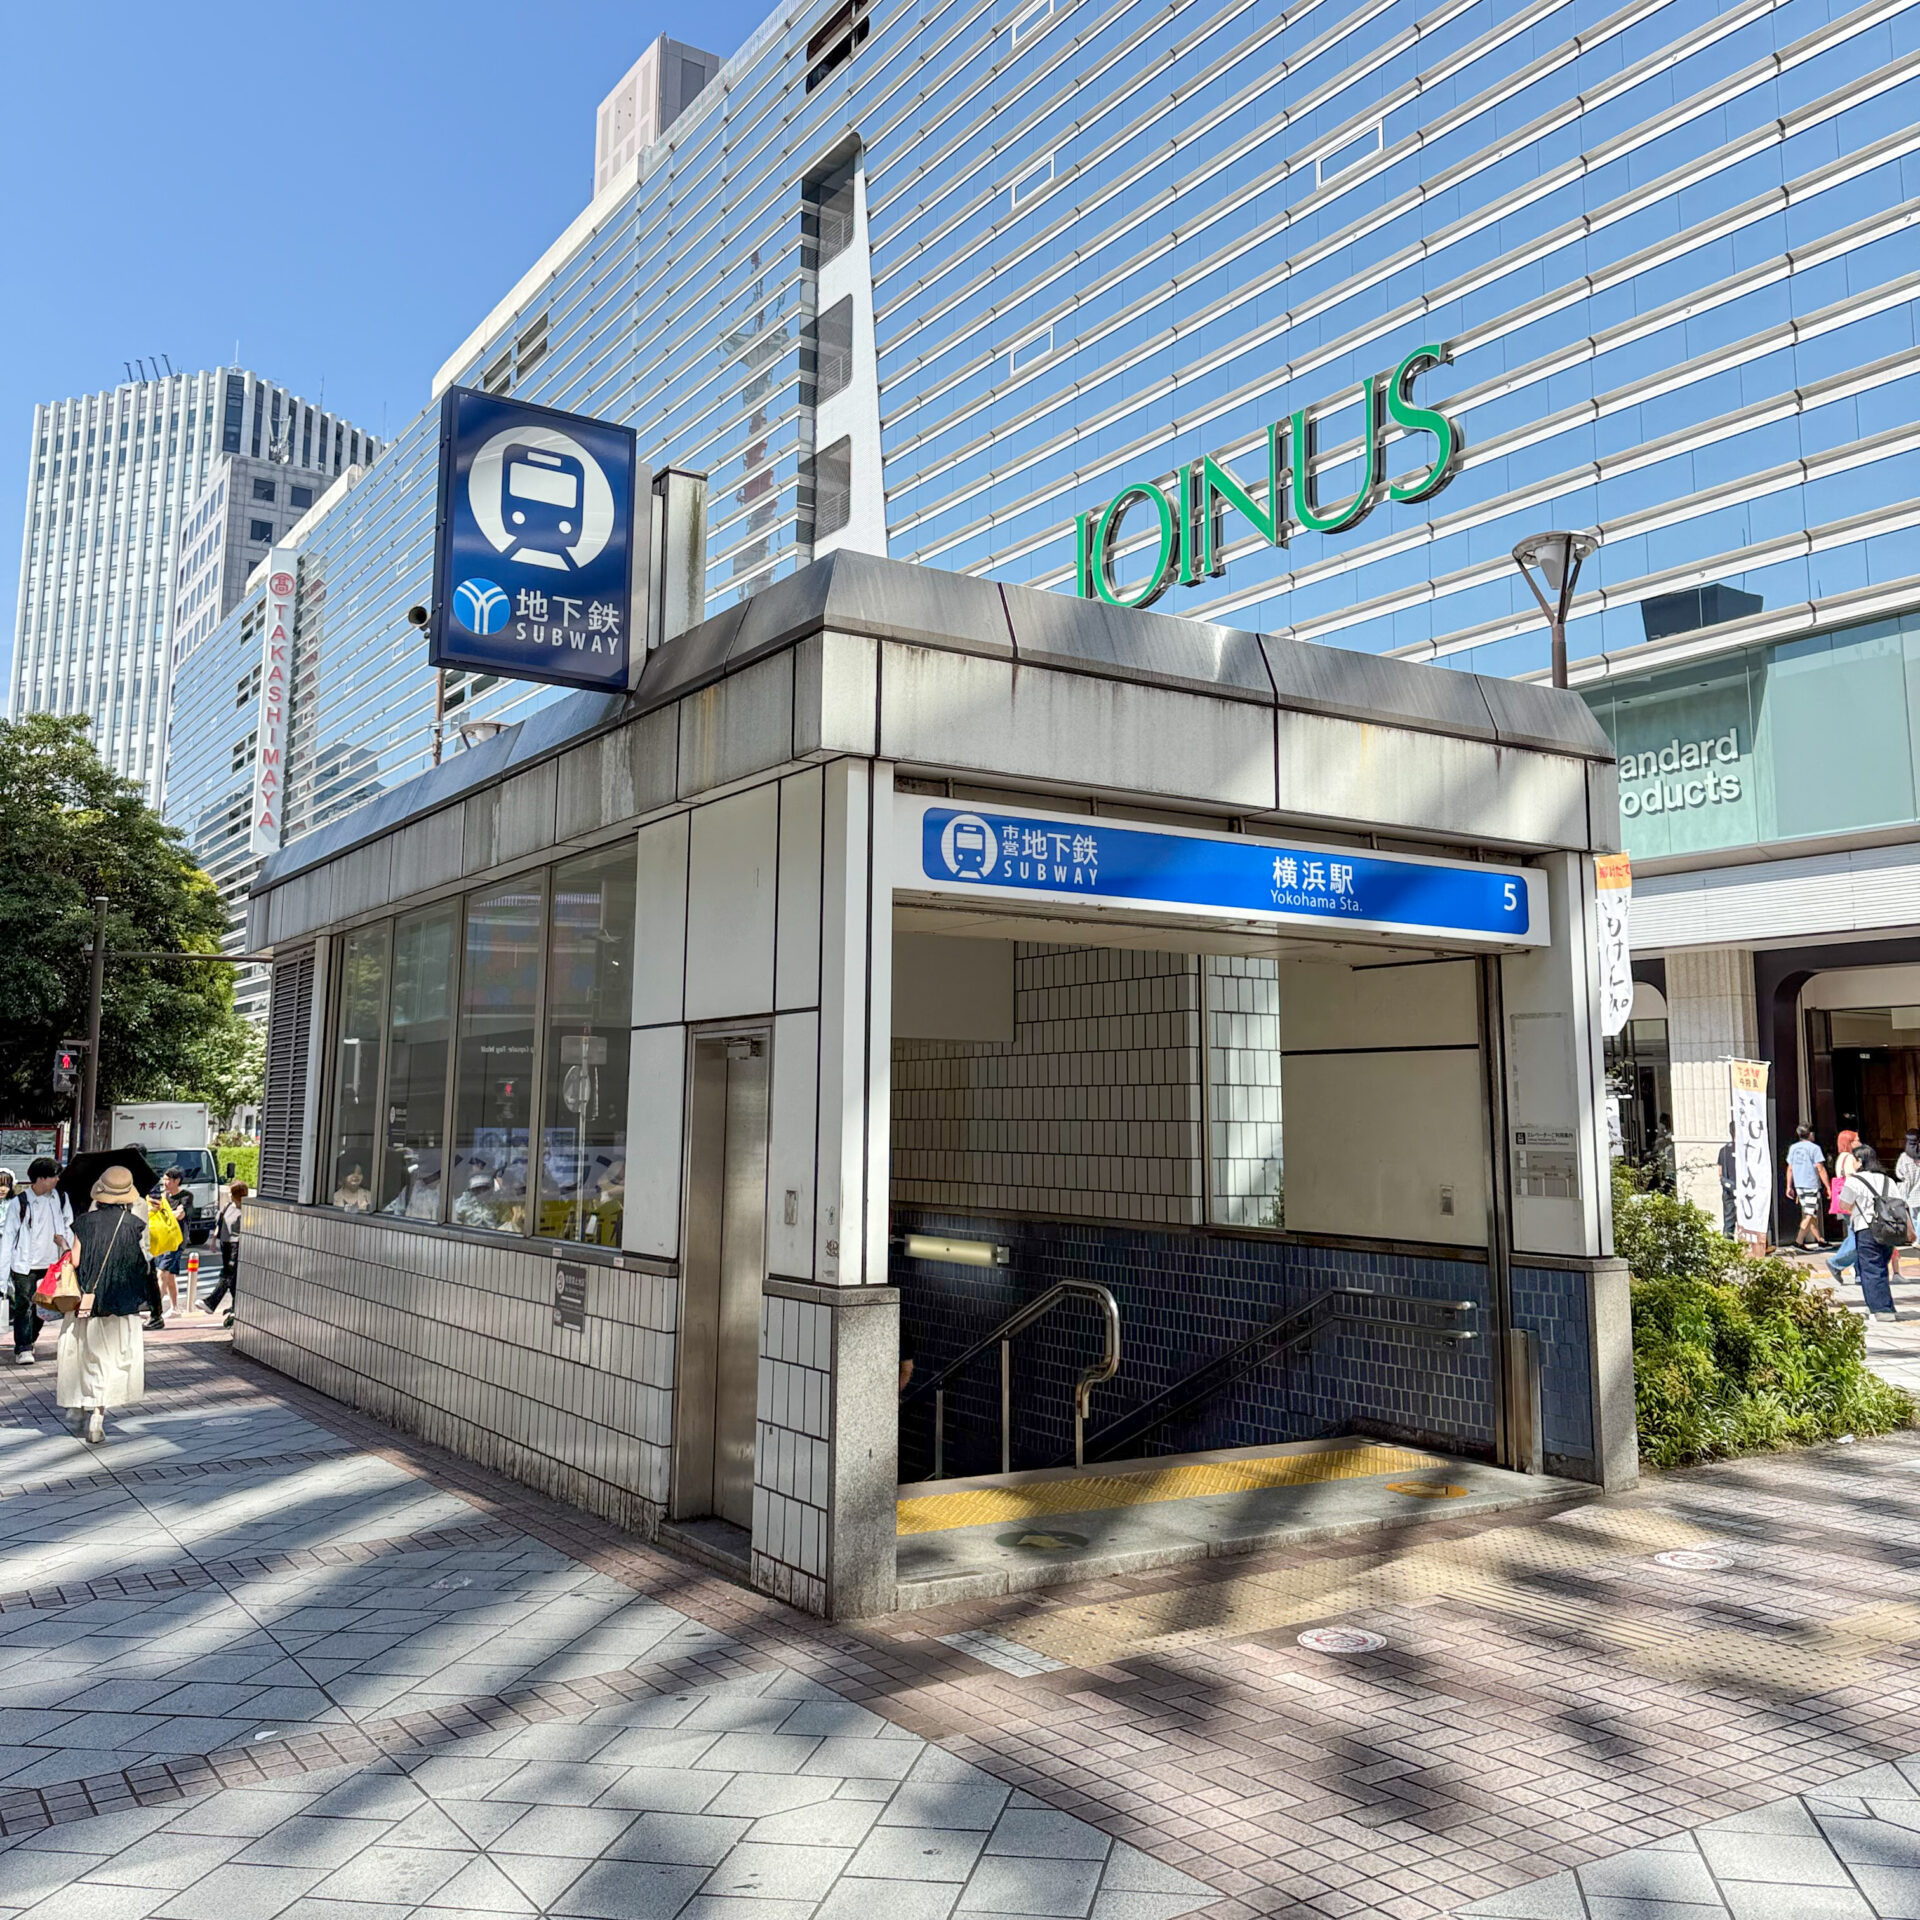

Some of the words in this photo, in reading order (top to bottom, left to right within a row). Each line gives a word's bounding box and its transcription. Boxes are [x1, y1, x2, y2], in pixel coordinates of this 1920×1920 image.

[516, 588, 620, 635] 地下鉄
[516, 622, 618, 656] SUBWAY
[259, 604, 285, 827] TAKASHIMAYA
[1619, 728, 1740, 781] andard
[1619, 770, 1741, 817] oducts
[1003, 860, 1098, 886] SUBWAY
[1272, 856, 1354, 895] 横浜駅
[1270, 889, 1337, 909] Yokohama
[1340, 896, 1363, 912] Sta.
[1503, 882, 1518, 912] 5
